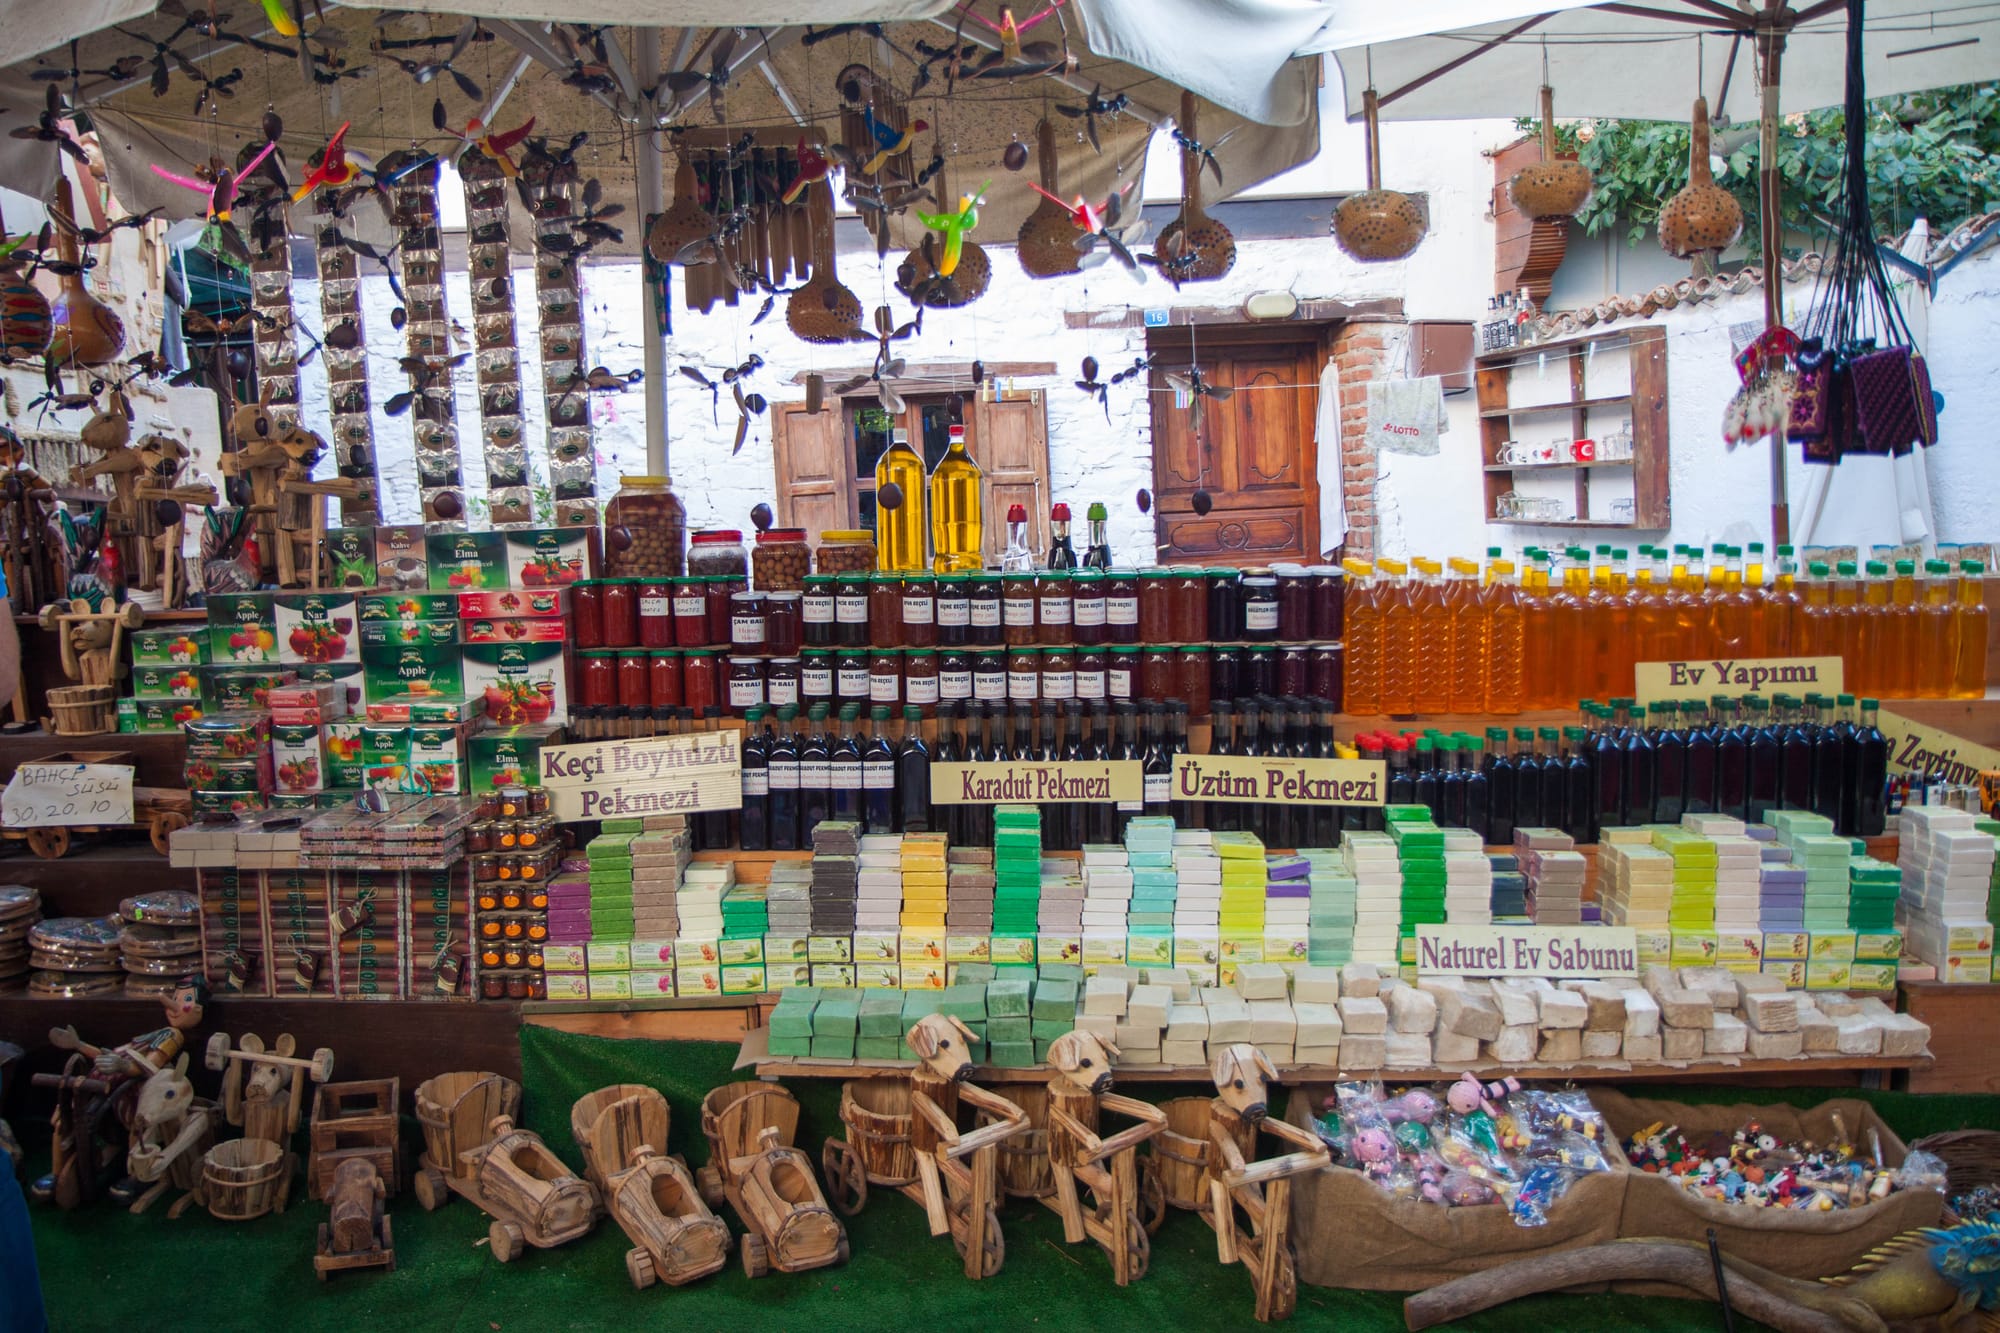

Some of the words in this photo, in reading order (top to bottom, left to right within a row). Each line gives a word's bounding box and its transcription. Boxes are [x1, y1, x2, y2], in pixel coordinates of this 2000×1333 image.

[1151, 313, 1163, 323] 16
[1393, 425, 1419, 436] LOTTO
[455, 549, 478, 558] Elma
[235, 611, 259, 621] Apple
[306, 611, 324, 619] Nar
[398, 665, 427, 677] Apple
[1668, 662, 1705, 686] Ev
[1712, 661, 1818, 691] Yapımı
[495, 754, 519, 763] Elma
[543, 747, 605, 782] Keçi
[612, 743, 737, 779] Boynuzu
[961, 768, 1032, 800] Karadut
[1036, 767, 1111, 800] Pekmezi
[1180, 761, 1258, 798] Üzüm
[1265, 769, 1378, 802] Pekmezi
[581, 782, 701, 817] Pekmezi
[90, 800, 110, 813] 10
[1420, 936, 1507, 970] Naturel
[1512, 938, 1541, 970] Ev
[1548, 938, 1636, 971] Sabunu
